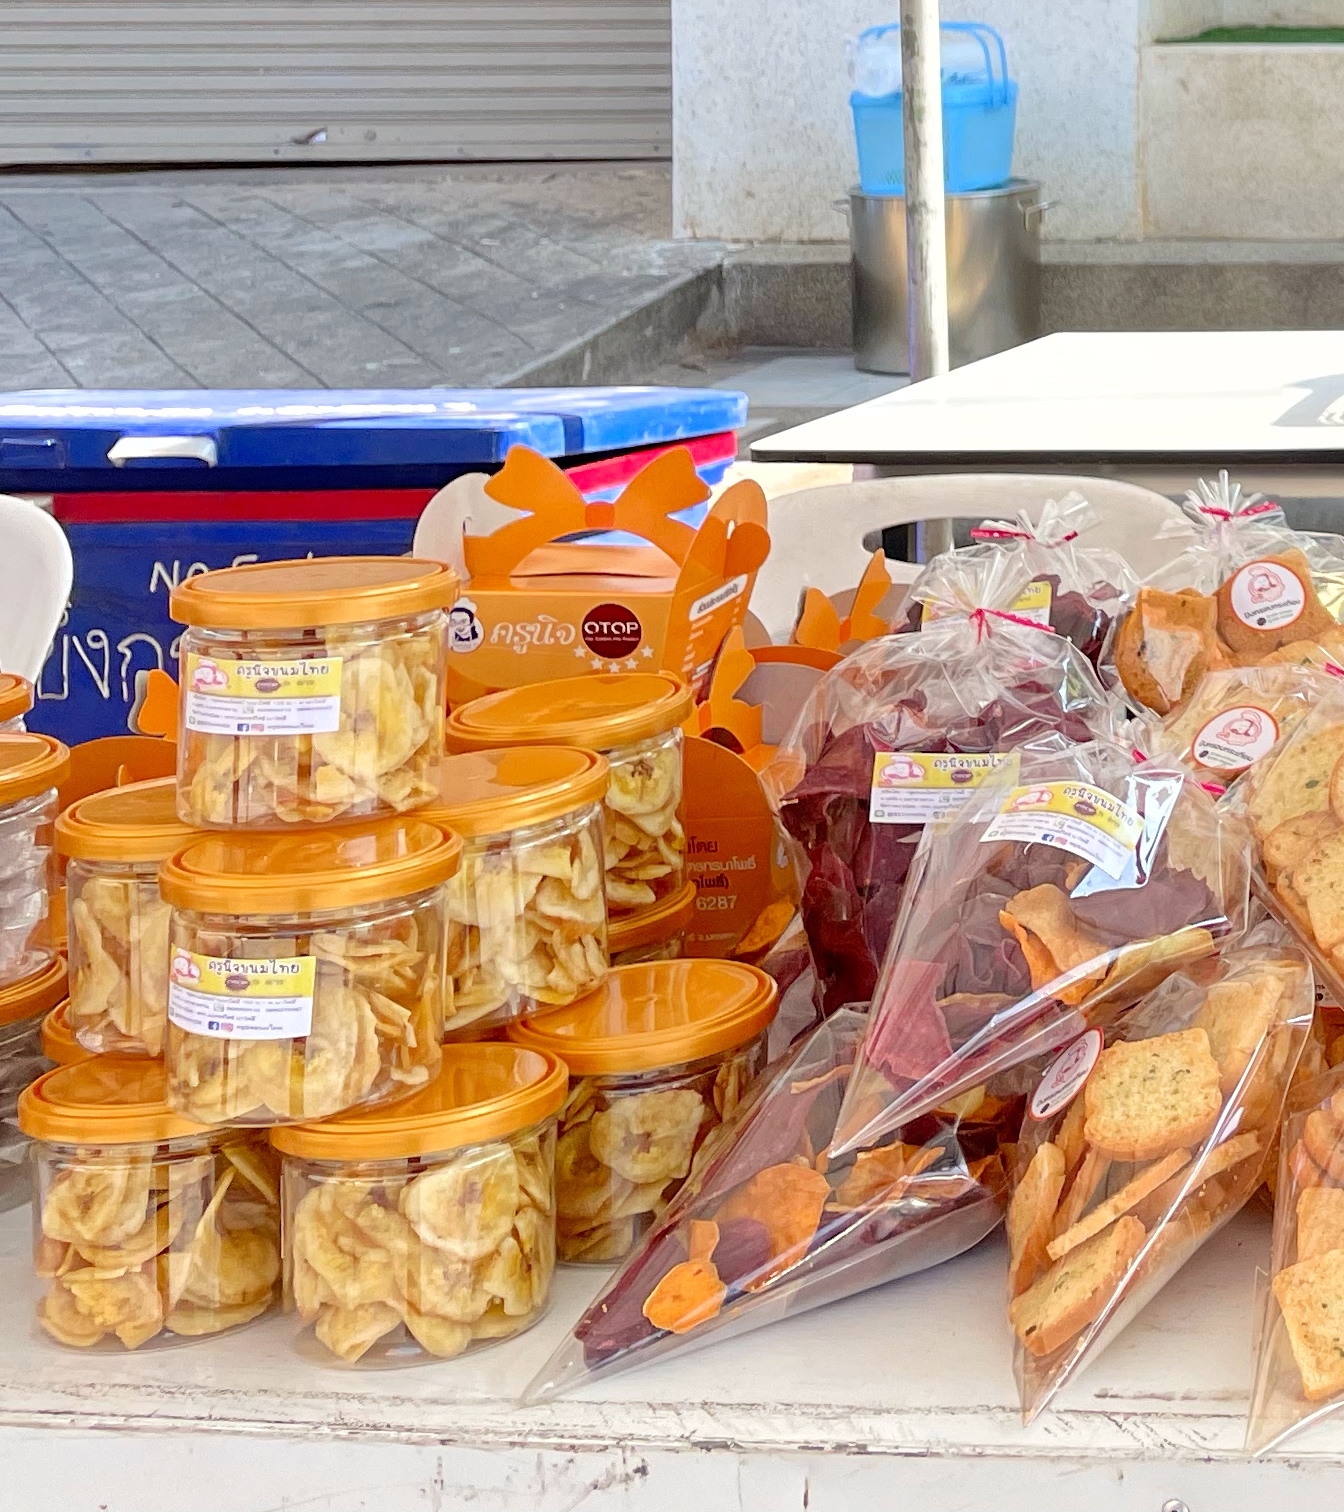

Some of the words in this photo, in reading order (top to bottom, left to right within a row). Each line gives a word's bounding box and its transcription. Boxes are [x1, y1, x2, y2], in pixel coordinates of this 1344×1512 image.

[490, 614, 576, 654] ครูนิจ
[584, 621, 639, 635] OTOP
